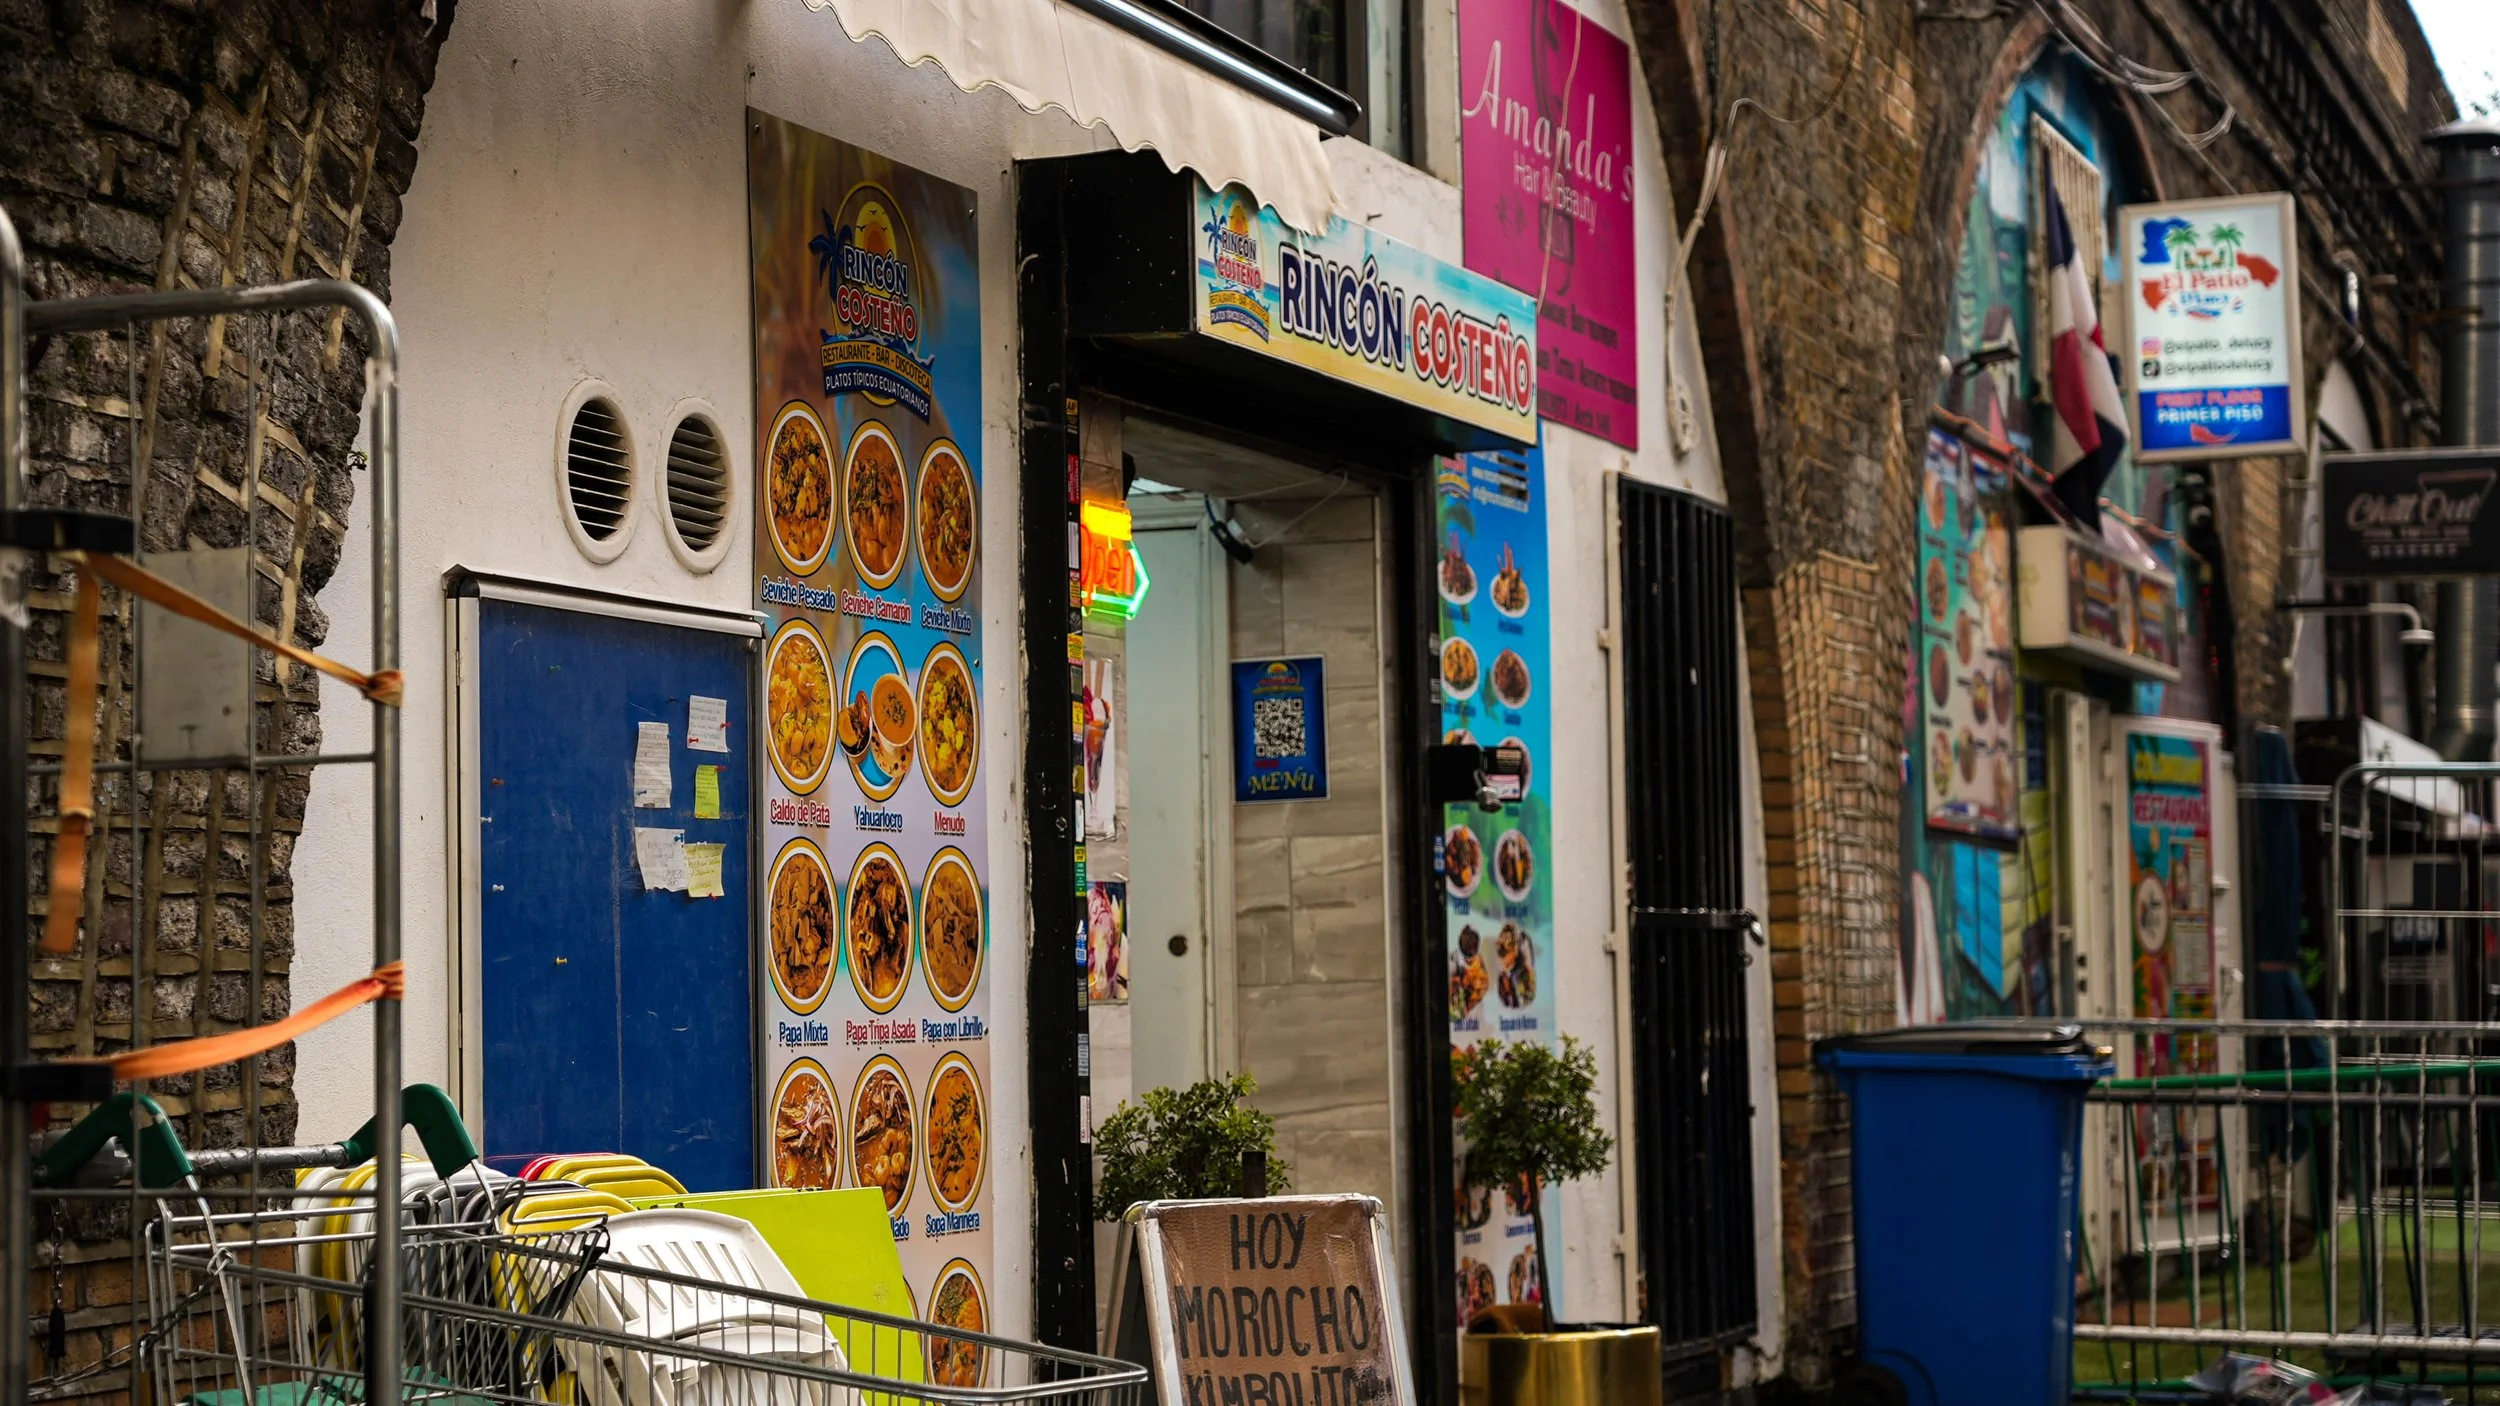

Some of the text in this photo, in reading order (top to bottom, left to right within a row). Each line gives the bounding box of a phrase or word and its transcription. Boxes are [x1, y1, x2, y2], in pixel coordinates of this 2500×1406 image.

[1462, 39, 1634, 203] Amanda's
[1513, 150, 1540, 194] Hair
[843, 246, 908, 297] RINCÓN
[2191, 271, 2249, 291] Patio
[837, 285, 917, 341] COSTEÑO
[1279, 243, 1405, 371] RINCÓN
[1411, 296, 1534, 415] COSTEÑO
[823, 344, 870, 364] RESTAURANTE
[876, 346, 890, 364] BAR
[895, 354, 931, 391] DISCOTECA
[826, 369, 929, 416] PLATOS TÍPICOS ECUATORIANOS
[2207, 388, 2263, 406] FLOOR
[2158, 404, 2264, 423] PRIMER PISO
[761, 577, 836, 611] Ceviche Pescado
[841, 590, 911, 621] Ceviche Camarón
[921, 603, 971, 632] Ceviche Mixto
[771, 799, 830, 825] Caldo de Pata
[854, 805, 902, 829] Yahuarlocro
[934, 812, 965, 832] Menudo
[779, 1019, 829, 1046] Papa Mixta
[846, 1018, 916, 1044] Papa Tripa Asada
[922, 1015, 983, 1042] Papa con Librillo
[890, 1215, 909, 1238] lado
[925, 1209, 980, 1238] Sopa Marinera
[1230, 1213, 1306, 1270] HOY
[1174, 1285, 1370, 1358] MOROCHO
